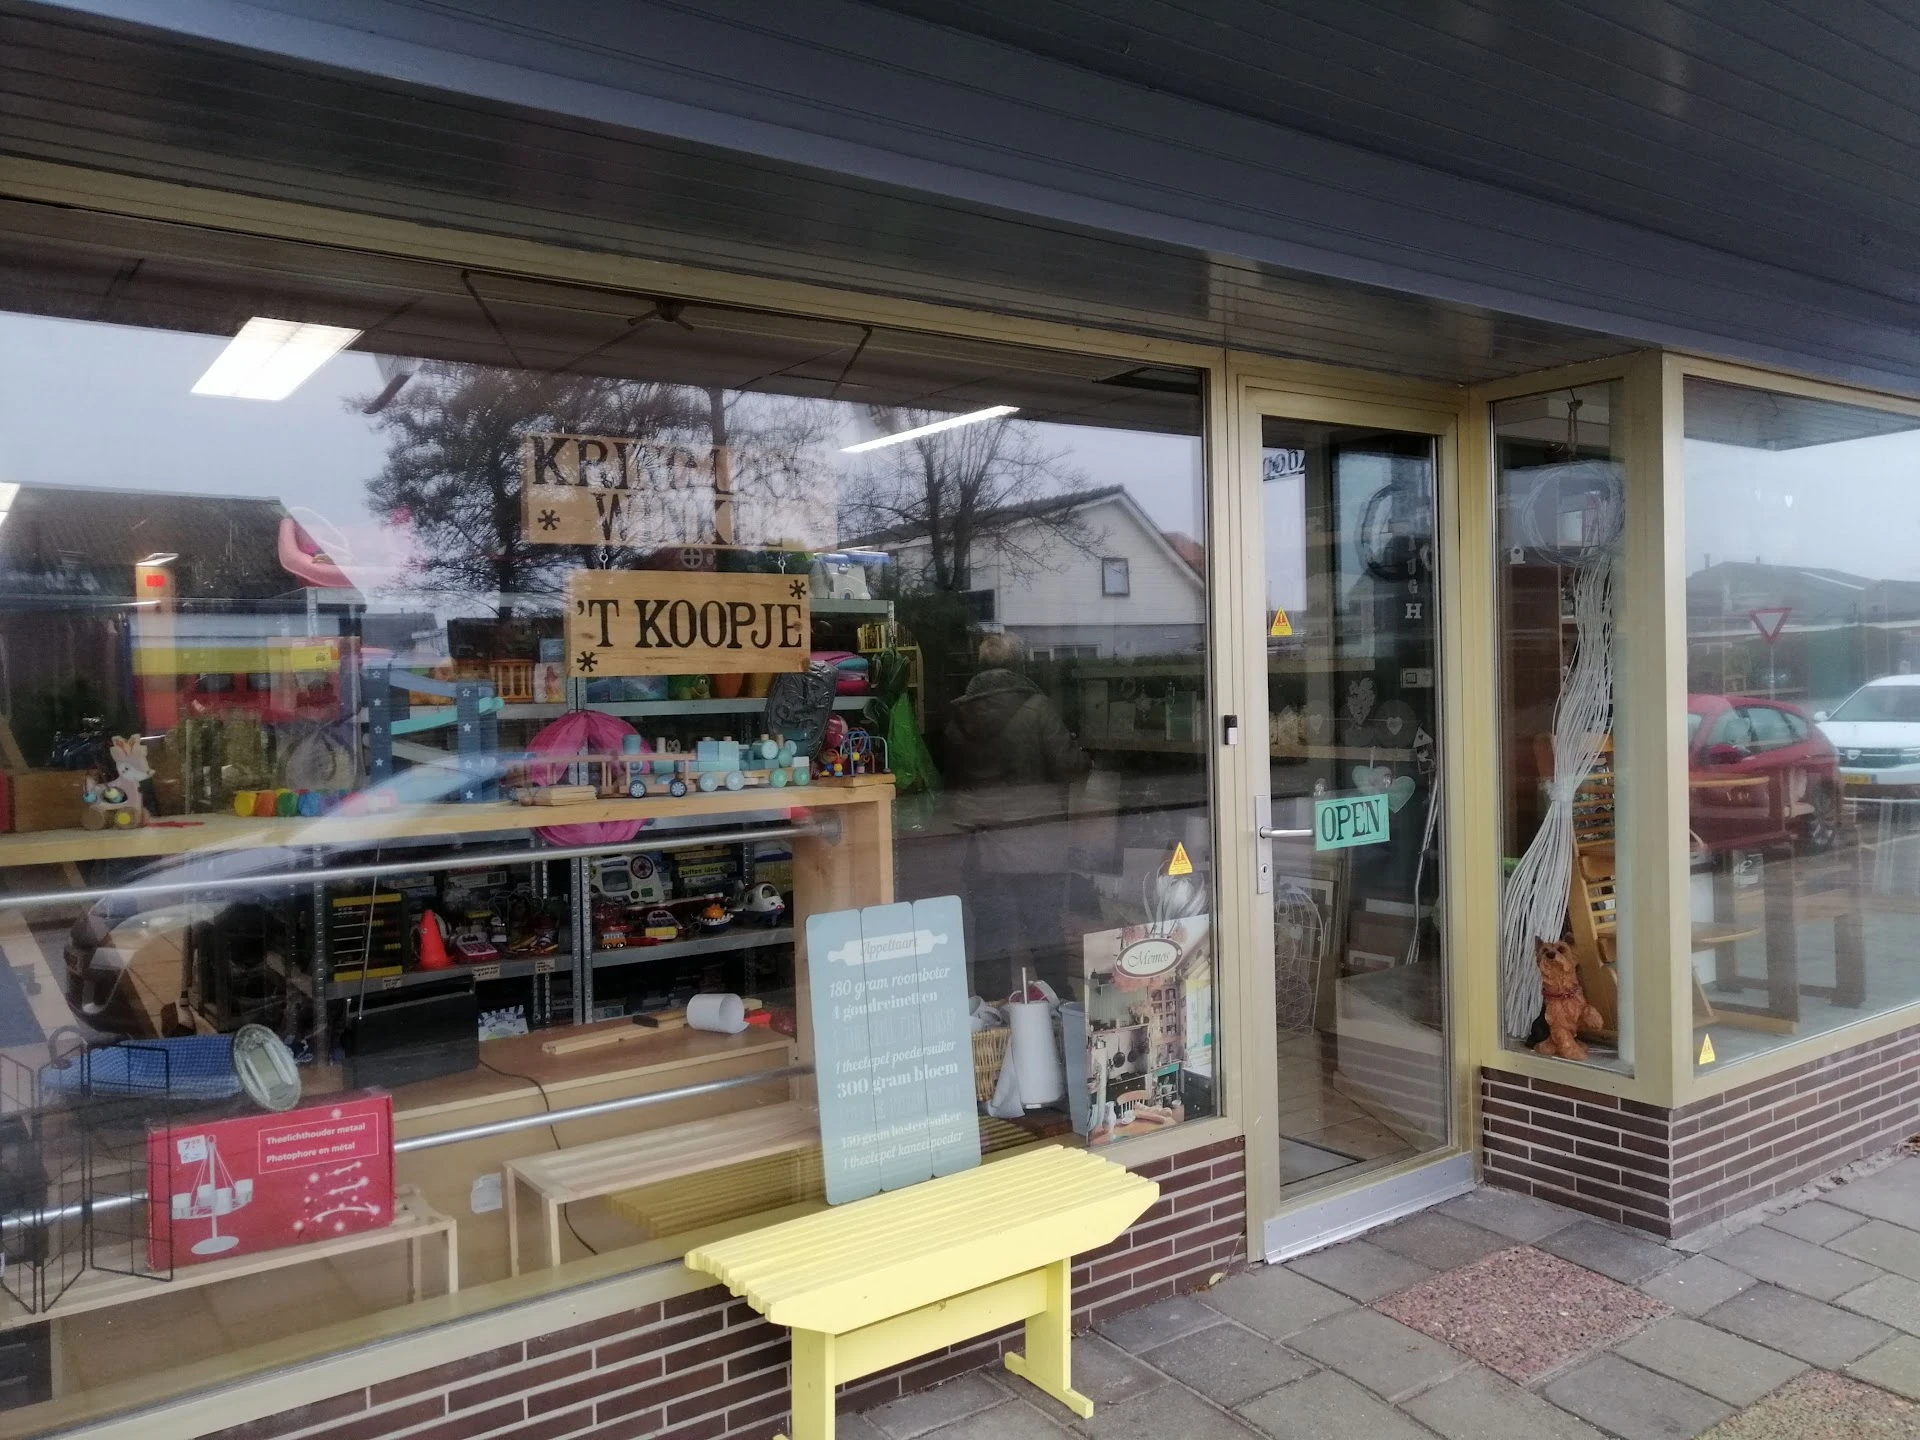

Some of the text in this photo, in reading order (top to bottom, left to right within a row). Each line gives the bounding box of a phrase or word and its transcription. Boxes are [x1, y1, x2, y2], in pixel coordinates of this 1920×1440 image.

[577, 599, 802, 650] 'T KOOPJE
[1321, 799, 1381, 842] OPEN
[860, 937, 918, 960] Appeltaart
[829, 966, 951, 1001] 180 gram roomboter
[832, 991, 938, 1022] 4 goudreinetten
[835, 1040, 957, 1075] 1 theelepel poedersuiker
[837, 1062, 959, 1099] 300 gram bloem
[266, 1122, 366, 1145] Theelichthouder metaal
[860, 1128, 890, 1146] gram
[266, 1141, 356, 1163] Photophore en métal
[843, 1157, 848, 1169] 1
[850, 1145, 896, 1169] theelepel
